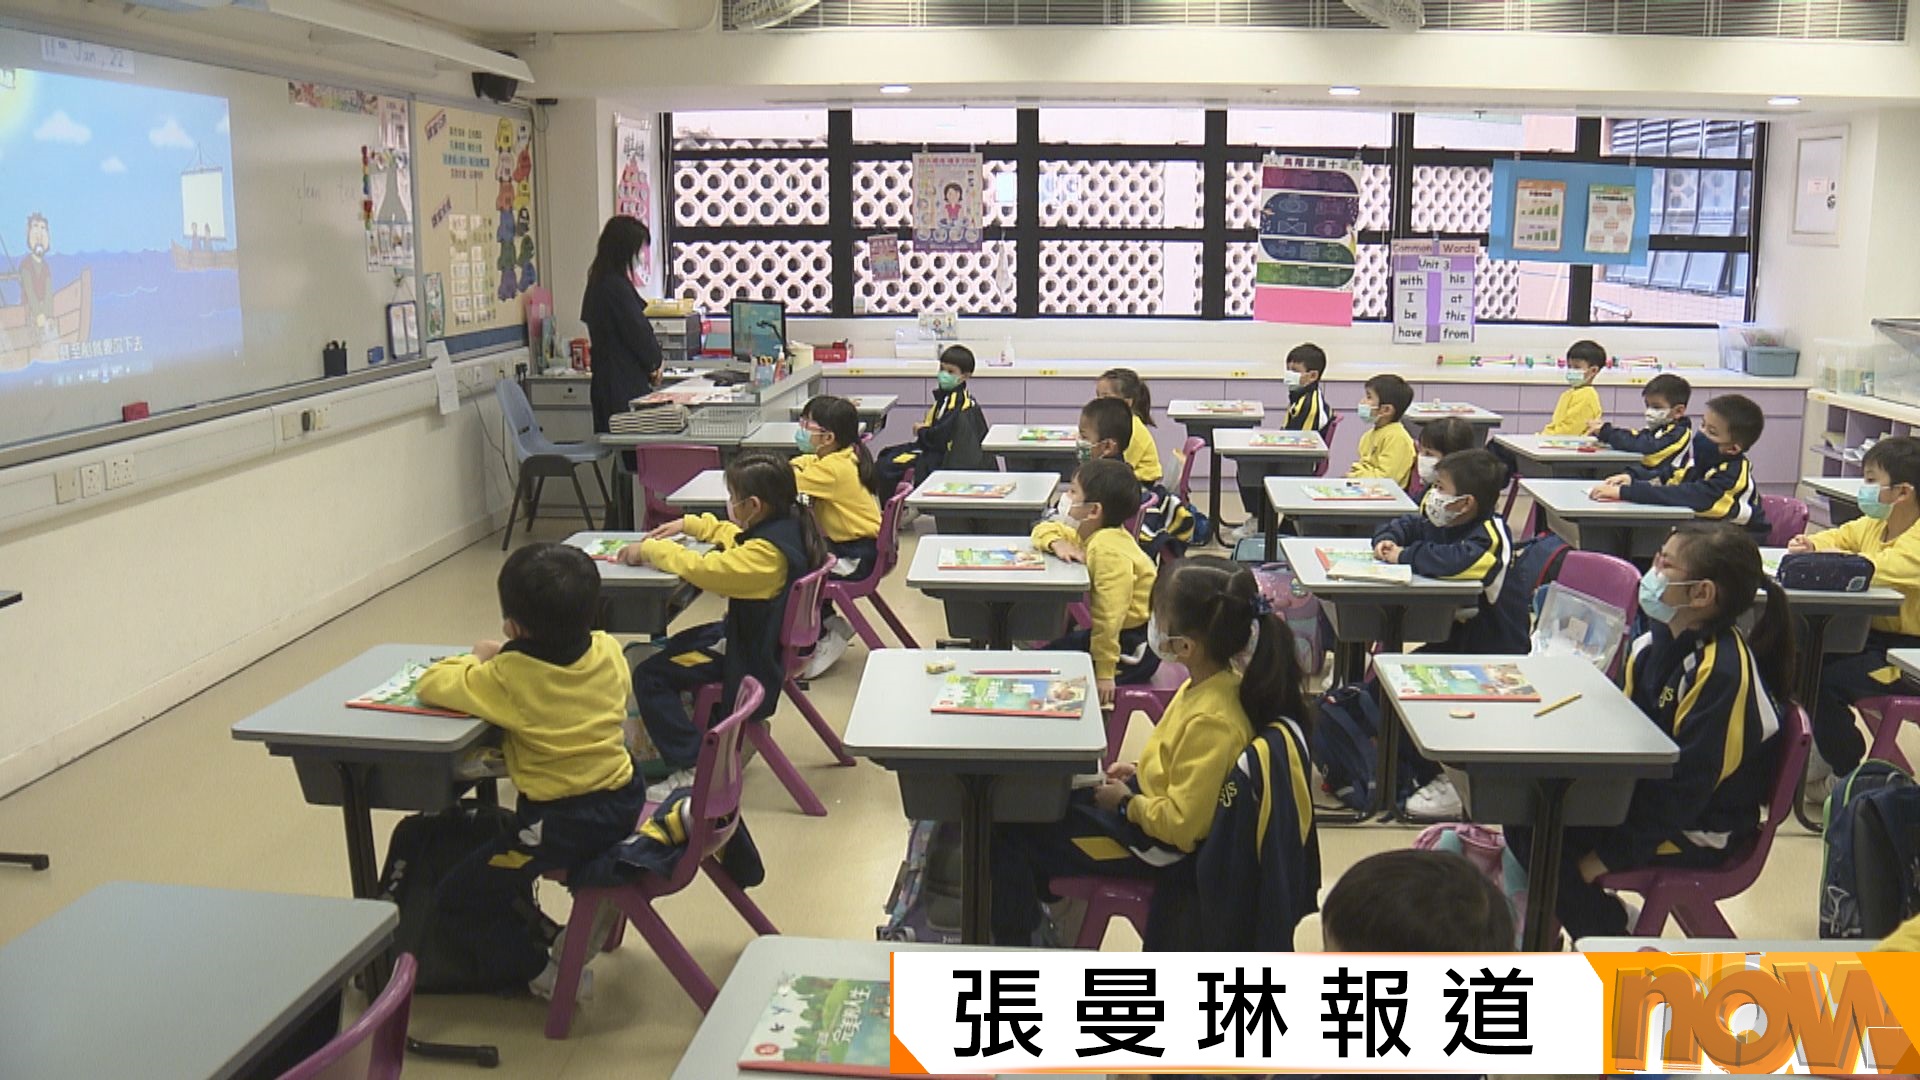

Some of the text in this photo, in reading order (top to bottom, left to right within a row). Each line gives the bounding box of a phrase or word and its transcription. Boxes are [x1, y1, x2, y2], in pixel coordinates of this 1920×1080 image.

[1393, 244, 1476, 253] Common Words
[1419, 259, 1450, 271] Unit 3
[1400, 274, 1465, 285] with his
[1407, 292, 1463, 303] I at
[1404, 309, 1466, 321] be this
[1398, 327, 1469, 338] have from
